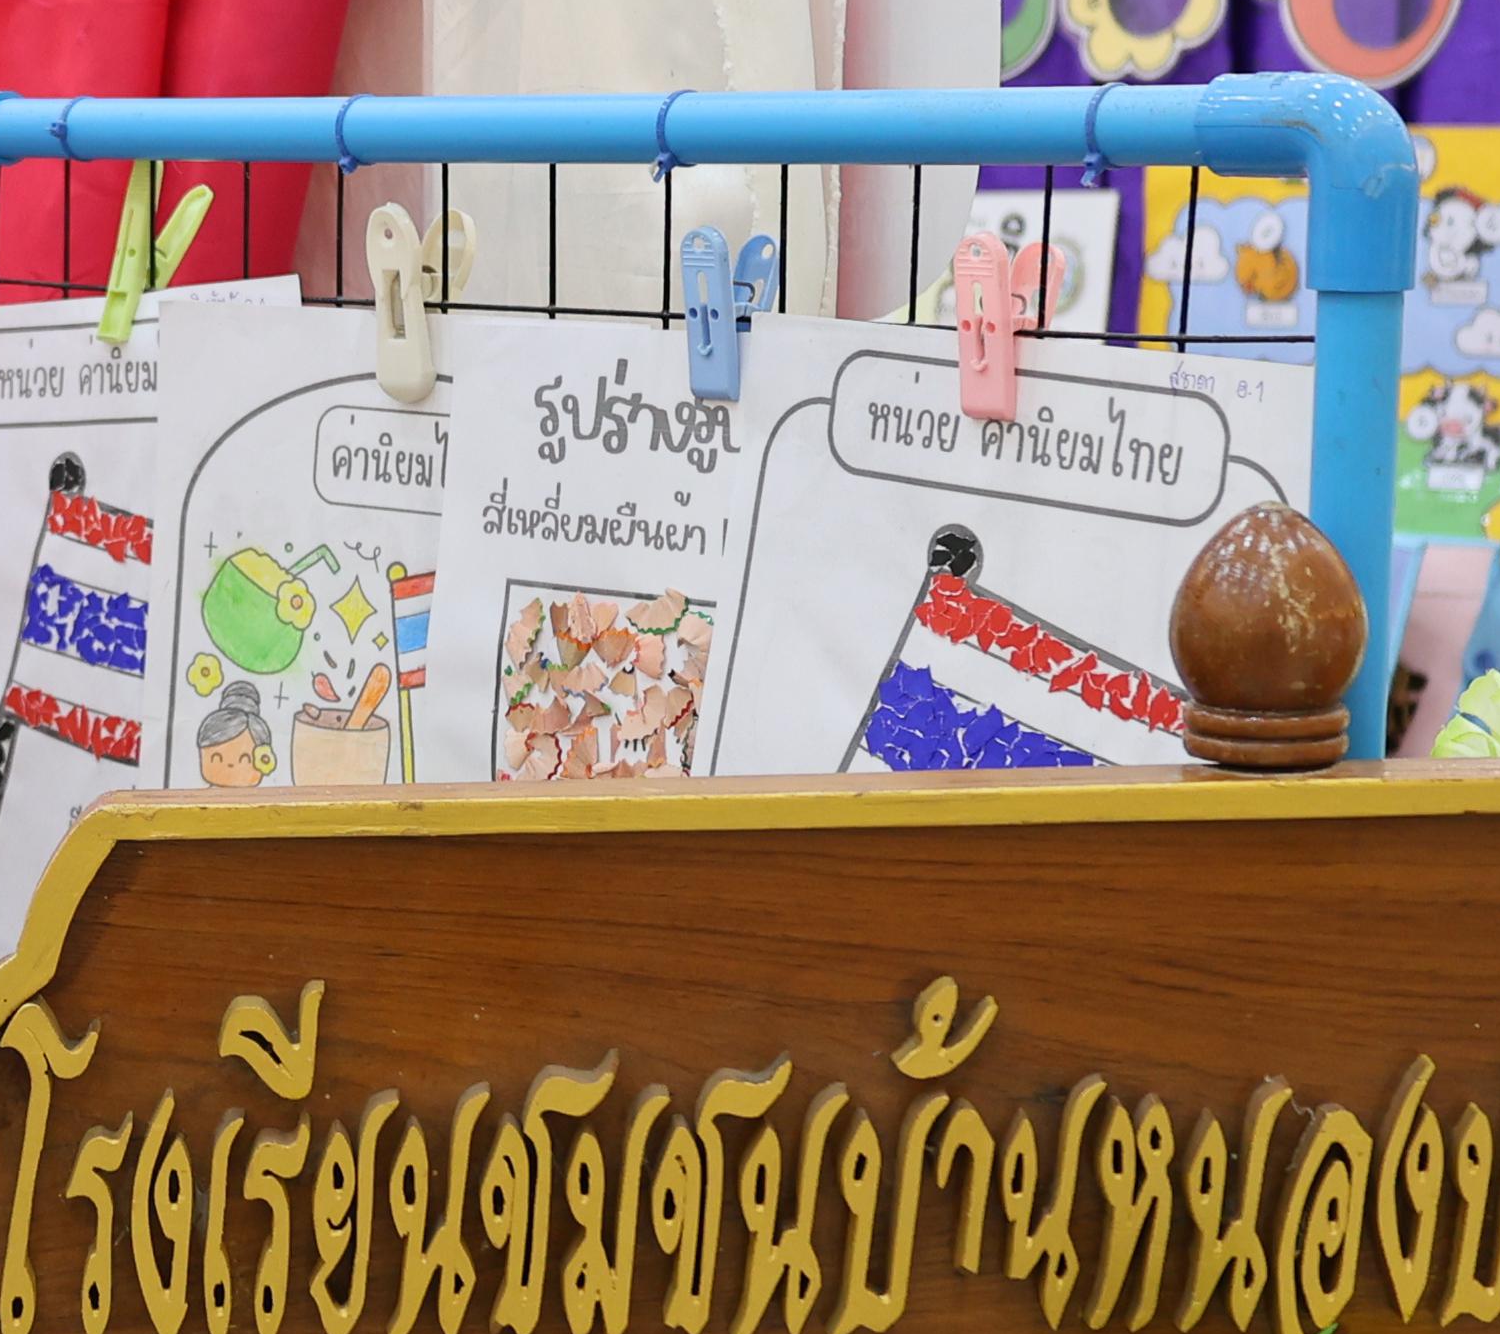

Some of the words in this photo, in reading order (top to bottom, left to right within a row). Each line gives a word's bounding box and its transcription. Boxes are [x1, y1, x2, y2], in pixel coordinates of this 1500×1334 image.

[867, 371, 961, 453] หน่วย
[981, 396, 1184, 486] คานิยมไทย
